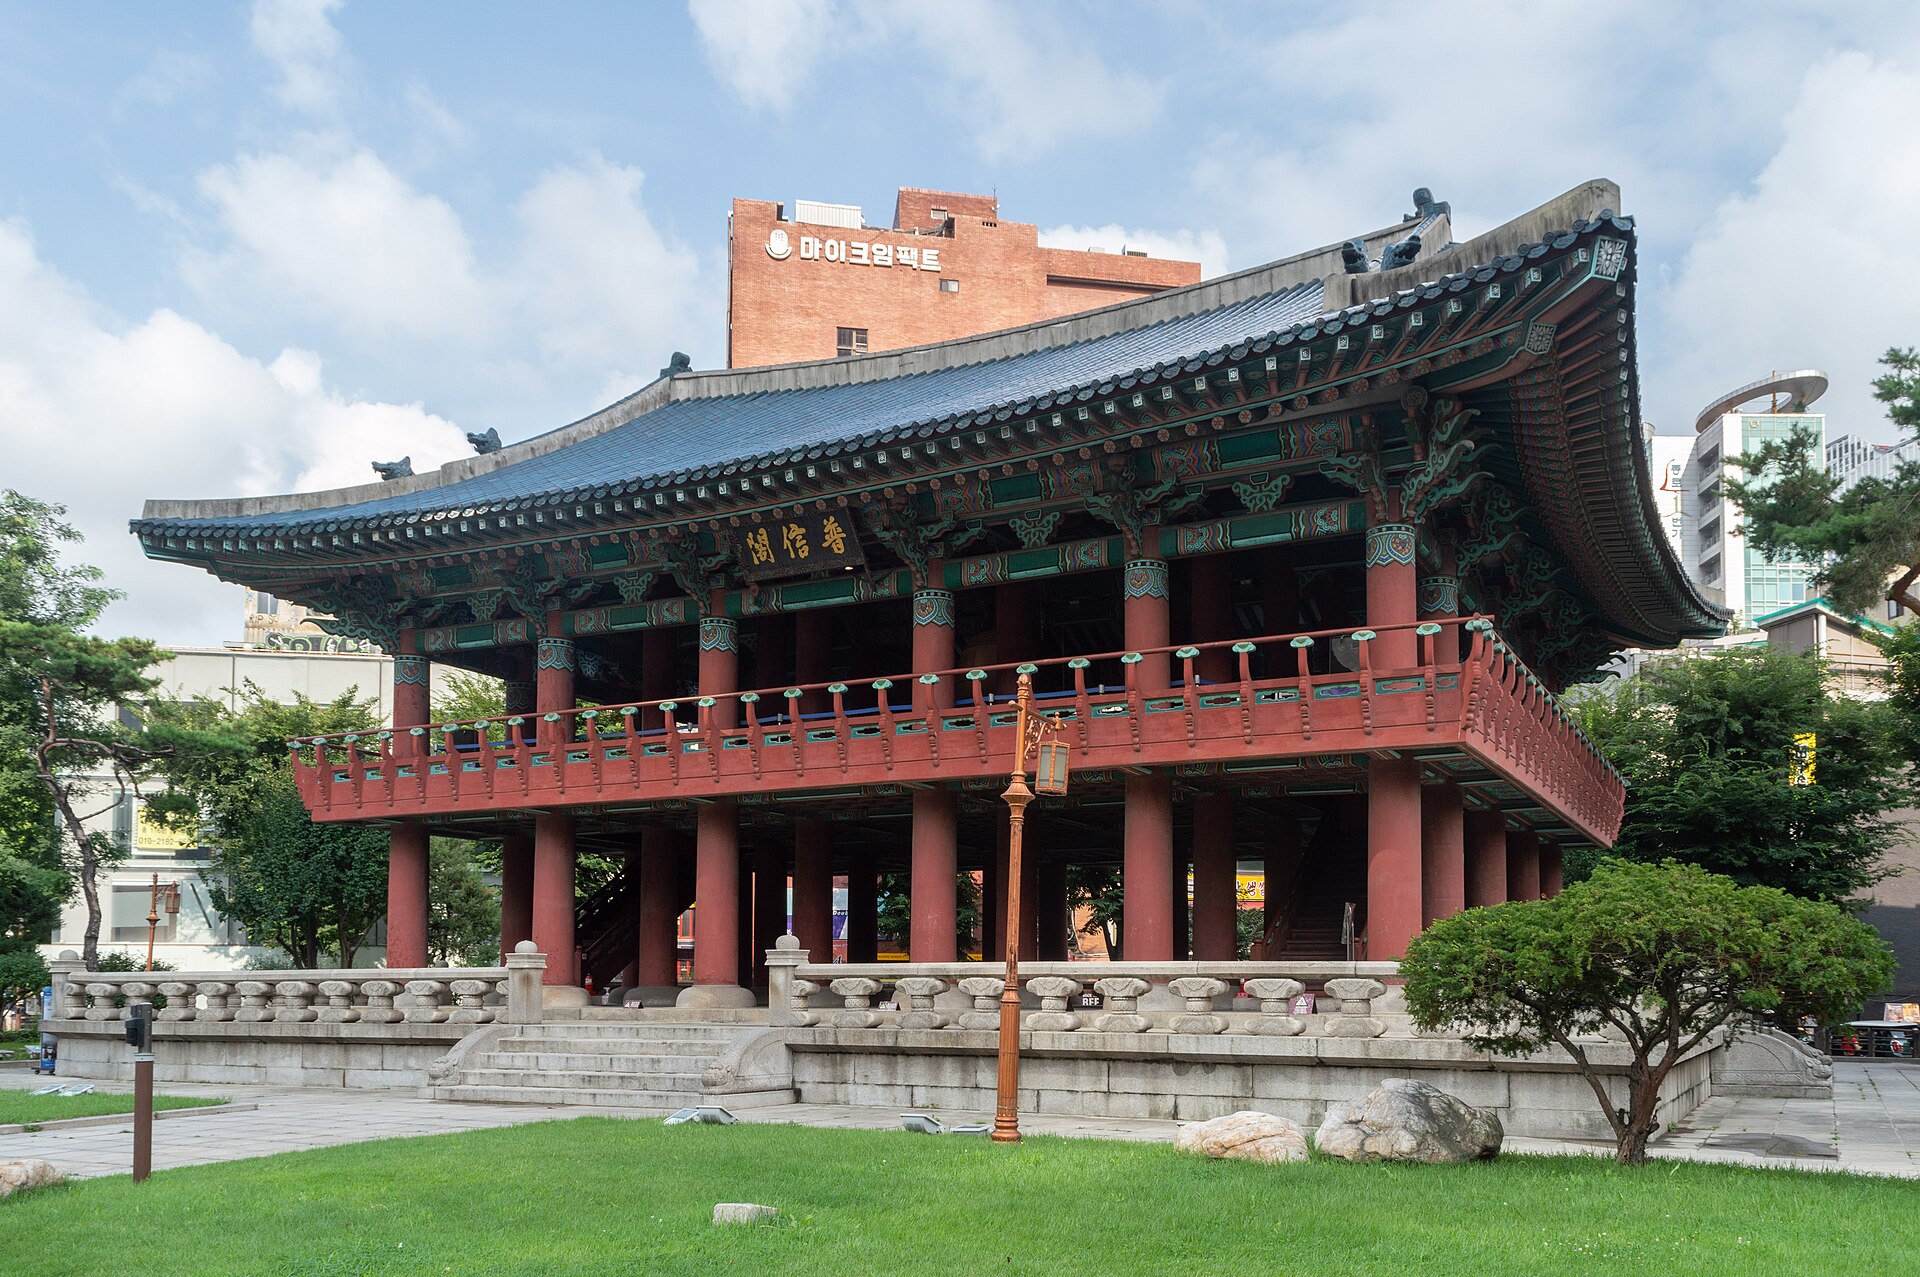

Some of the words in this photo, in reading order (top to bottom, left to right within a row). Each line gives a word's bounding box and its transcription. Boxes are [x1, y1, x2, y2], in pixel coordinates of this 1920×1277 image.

[800, 236, 942, 272] 마이크임팩트
[746, 515, 847, 565] 普信閣
